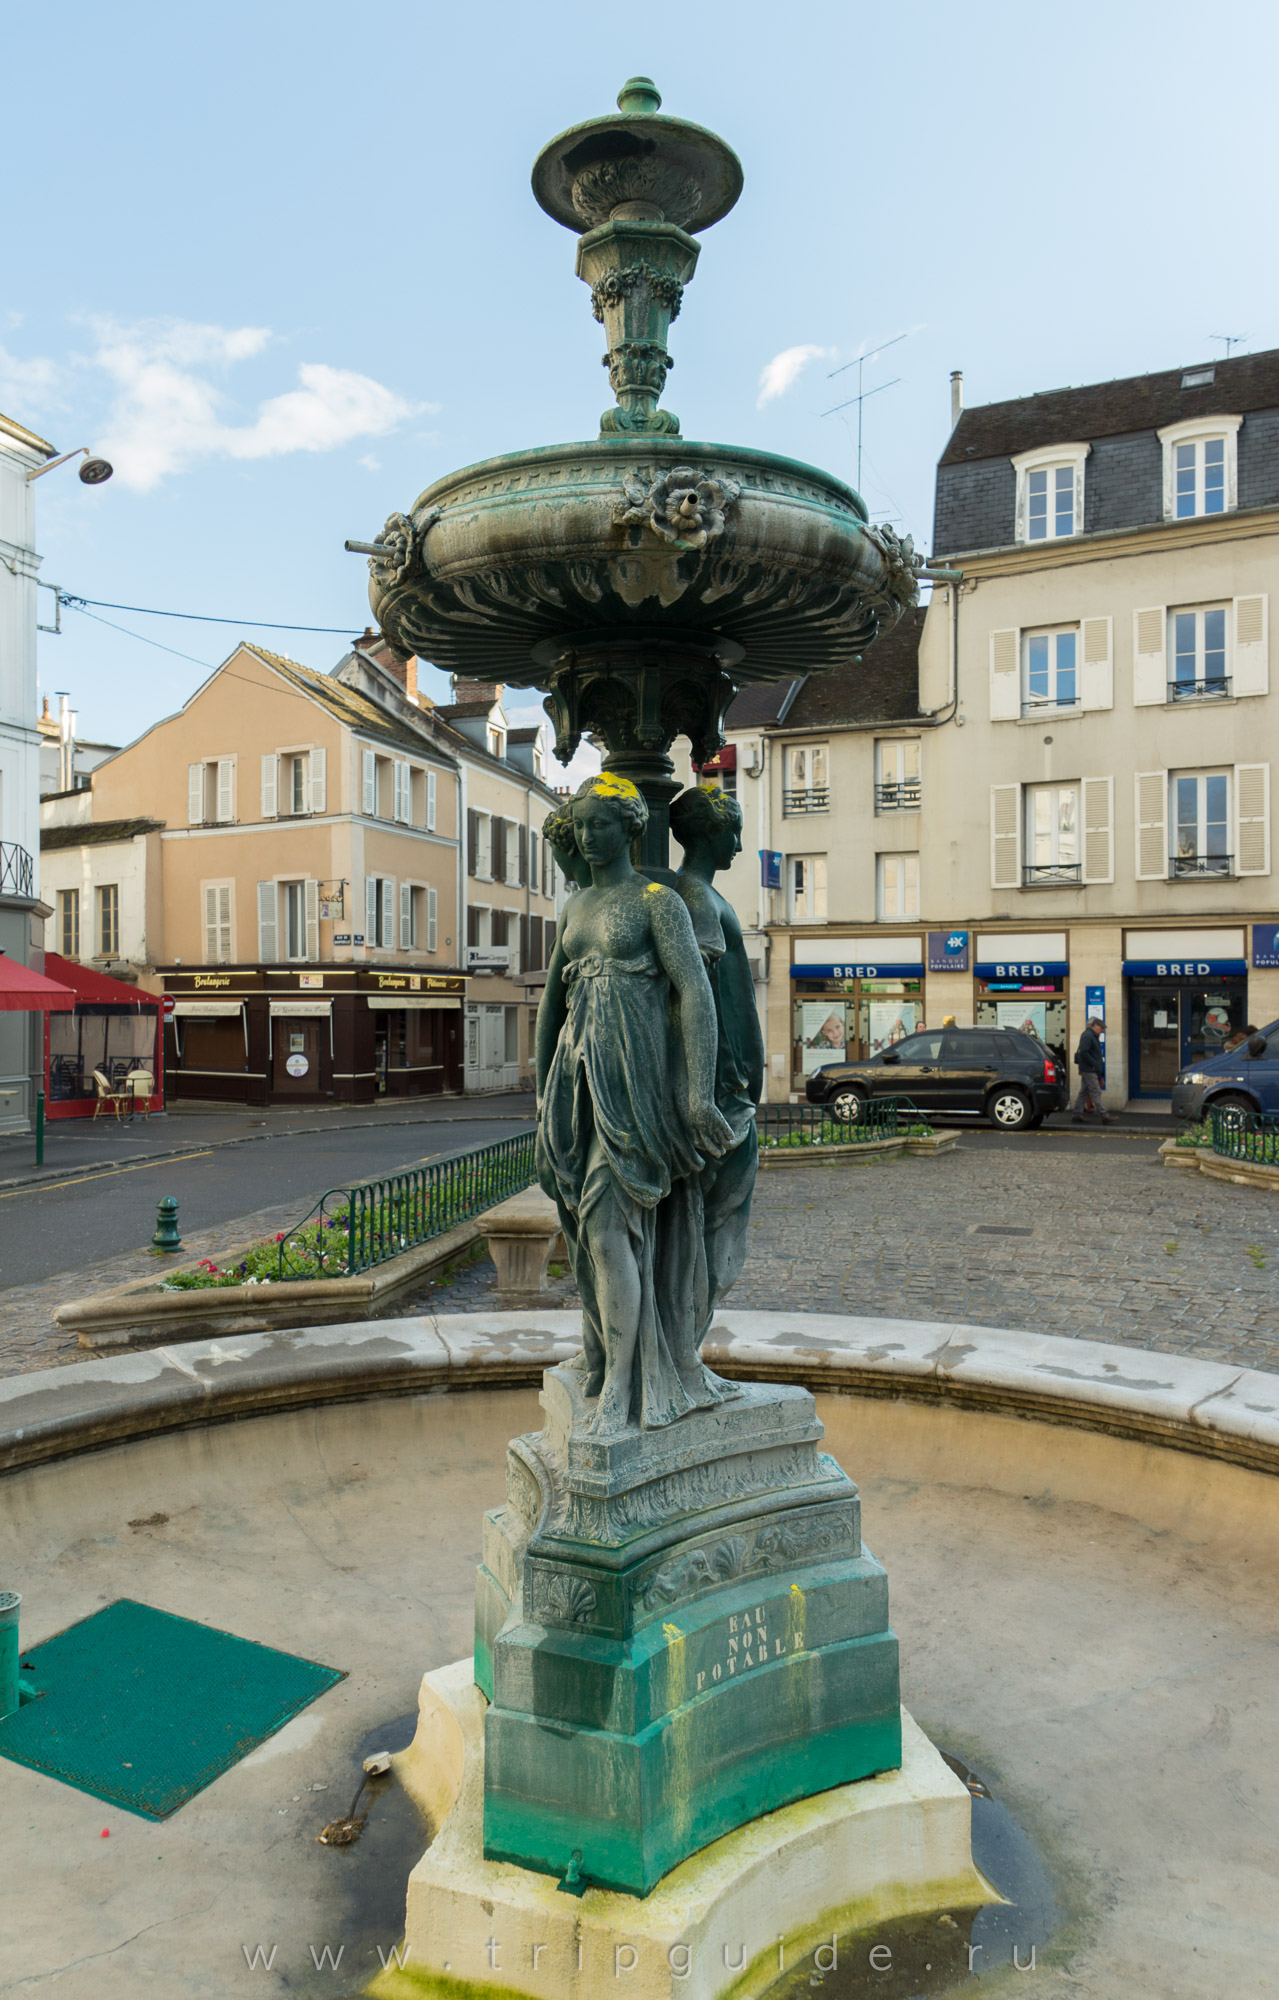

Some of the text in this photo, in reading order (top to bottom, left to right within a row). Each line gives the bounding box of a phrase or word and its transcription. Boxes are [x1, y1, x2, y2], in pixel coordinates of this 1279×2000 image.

[833, 966, 878, 978] BRED
[995, 965, 1045, 977] BRED
[1156, 963, 1211, 976] BRED
[194, 975, 231, 989] Boulangerie
[378, 975, 406, 989] Boulangerie
[728, 1606, 766, 1634] EAU
[728, 1625, 767, 1657] NON
[696, 1631, 804, 1691] POTABLE
